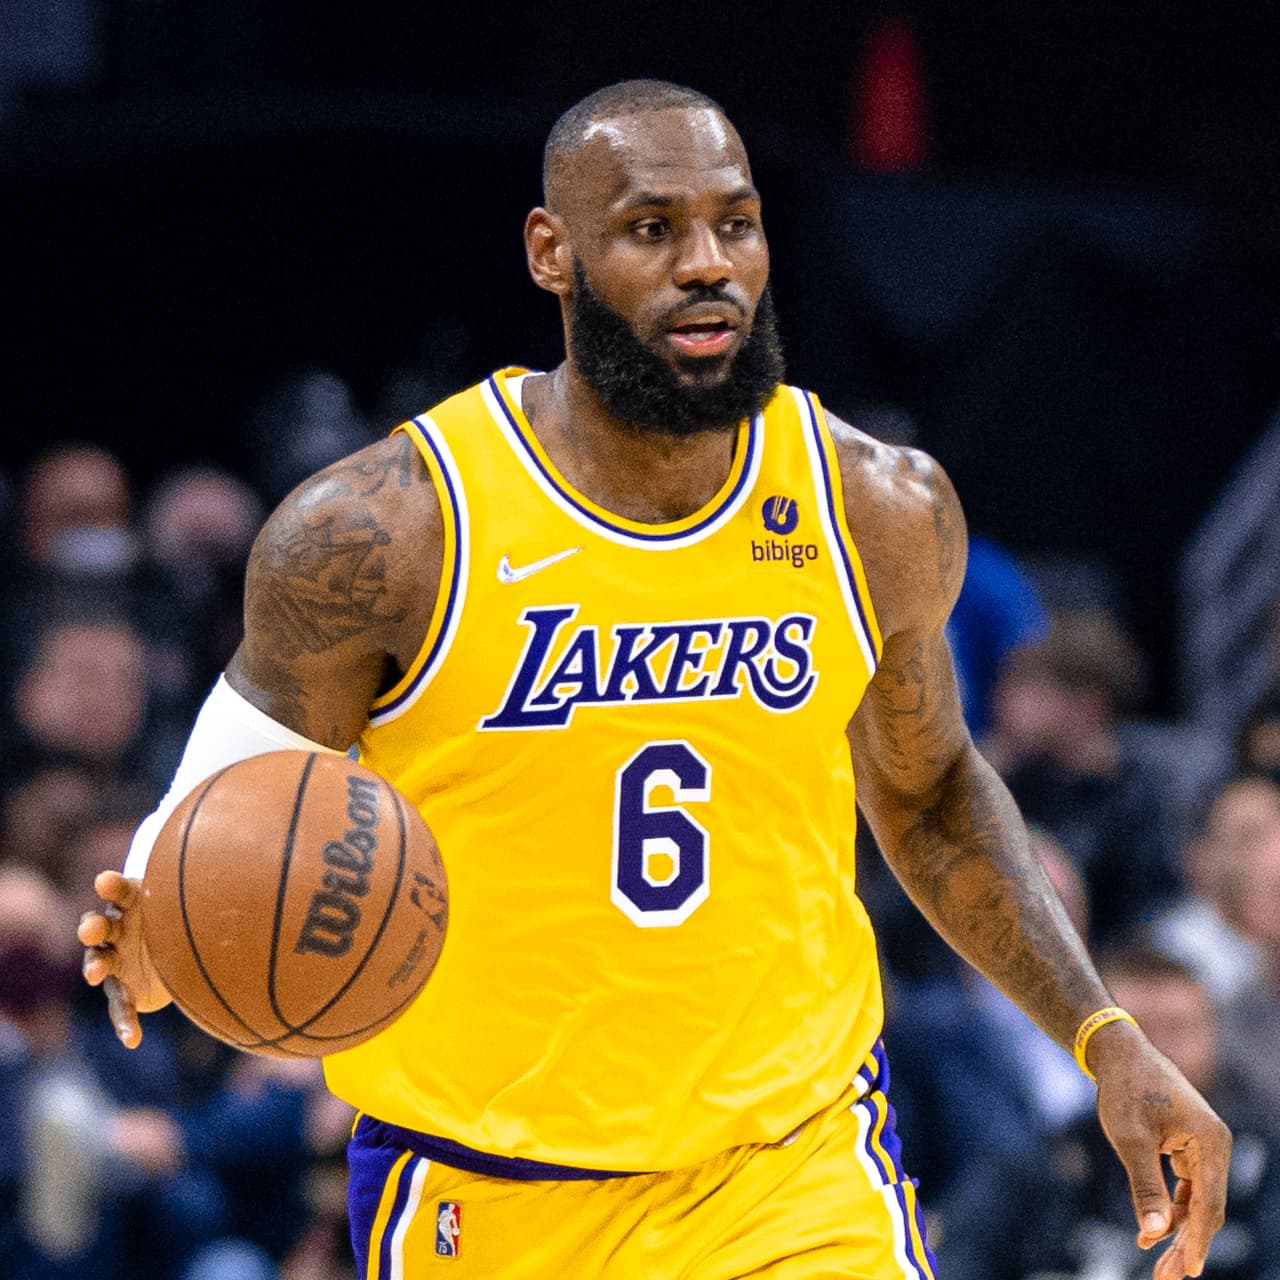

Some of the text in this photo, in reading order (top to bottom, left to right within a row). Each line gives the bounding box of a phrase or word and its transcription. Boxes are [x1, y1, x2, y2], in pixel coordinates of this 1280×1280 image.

[751, 539, 818, 568] bibigo
[476, 603, 819, 732] LAKERS
[293, 776, 381, 958] Wilson
[611, 739, 712, 928] 6
